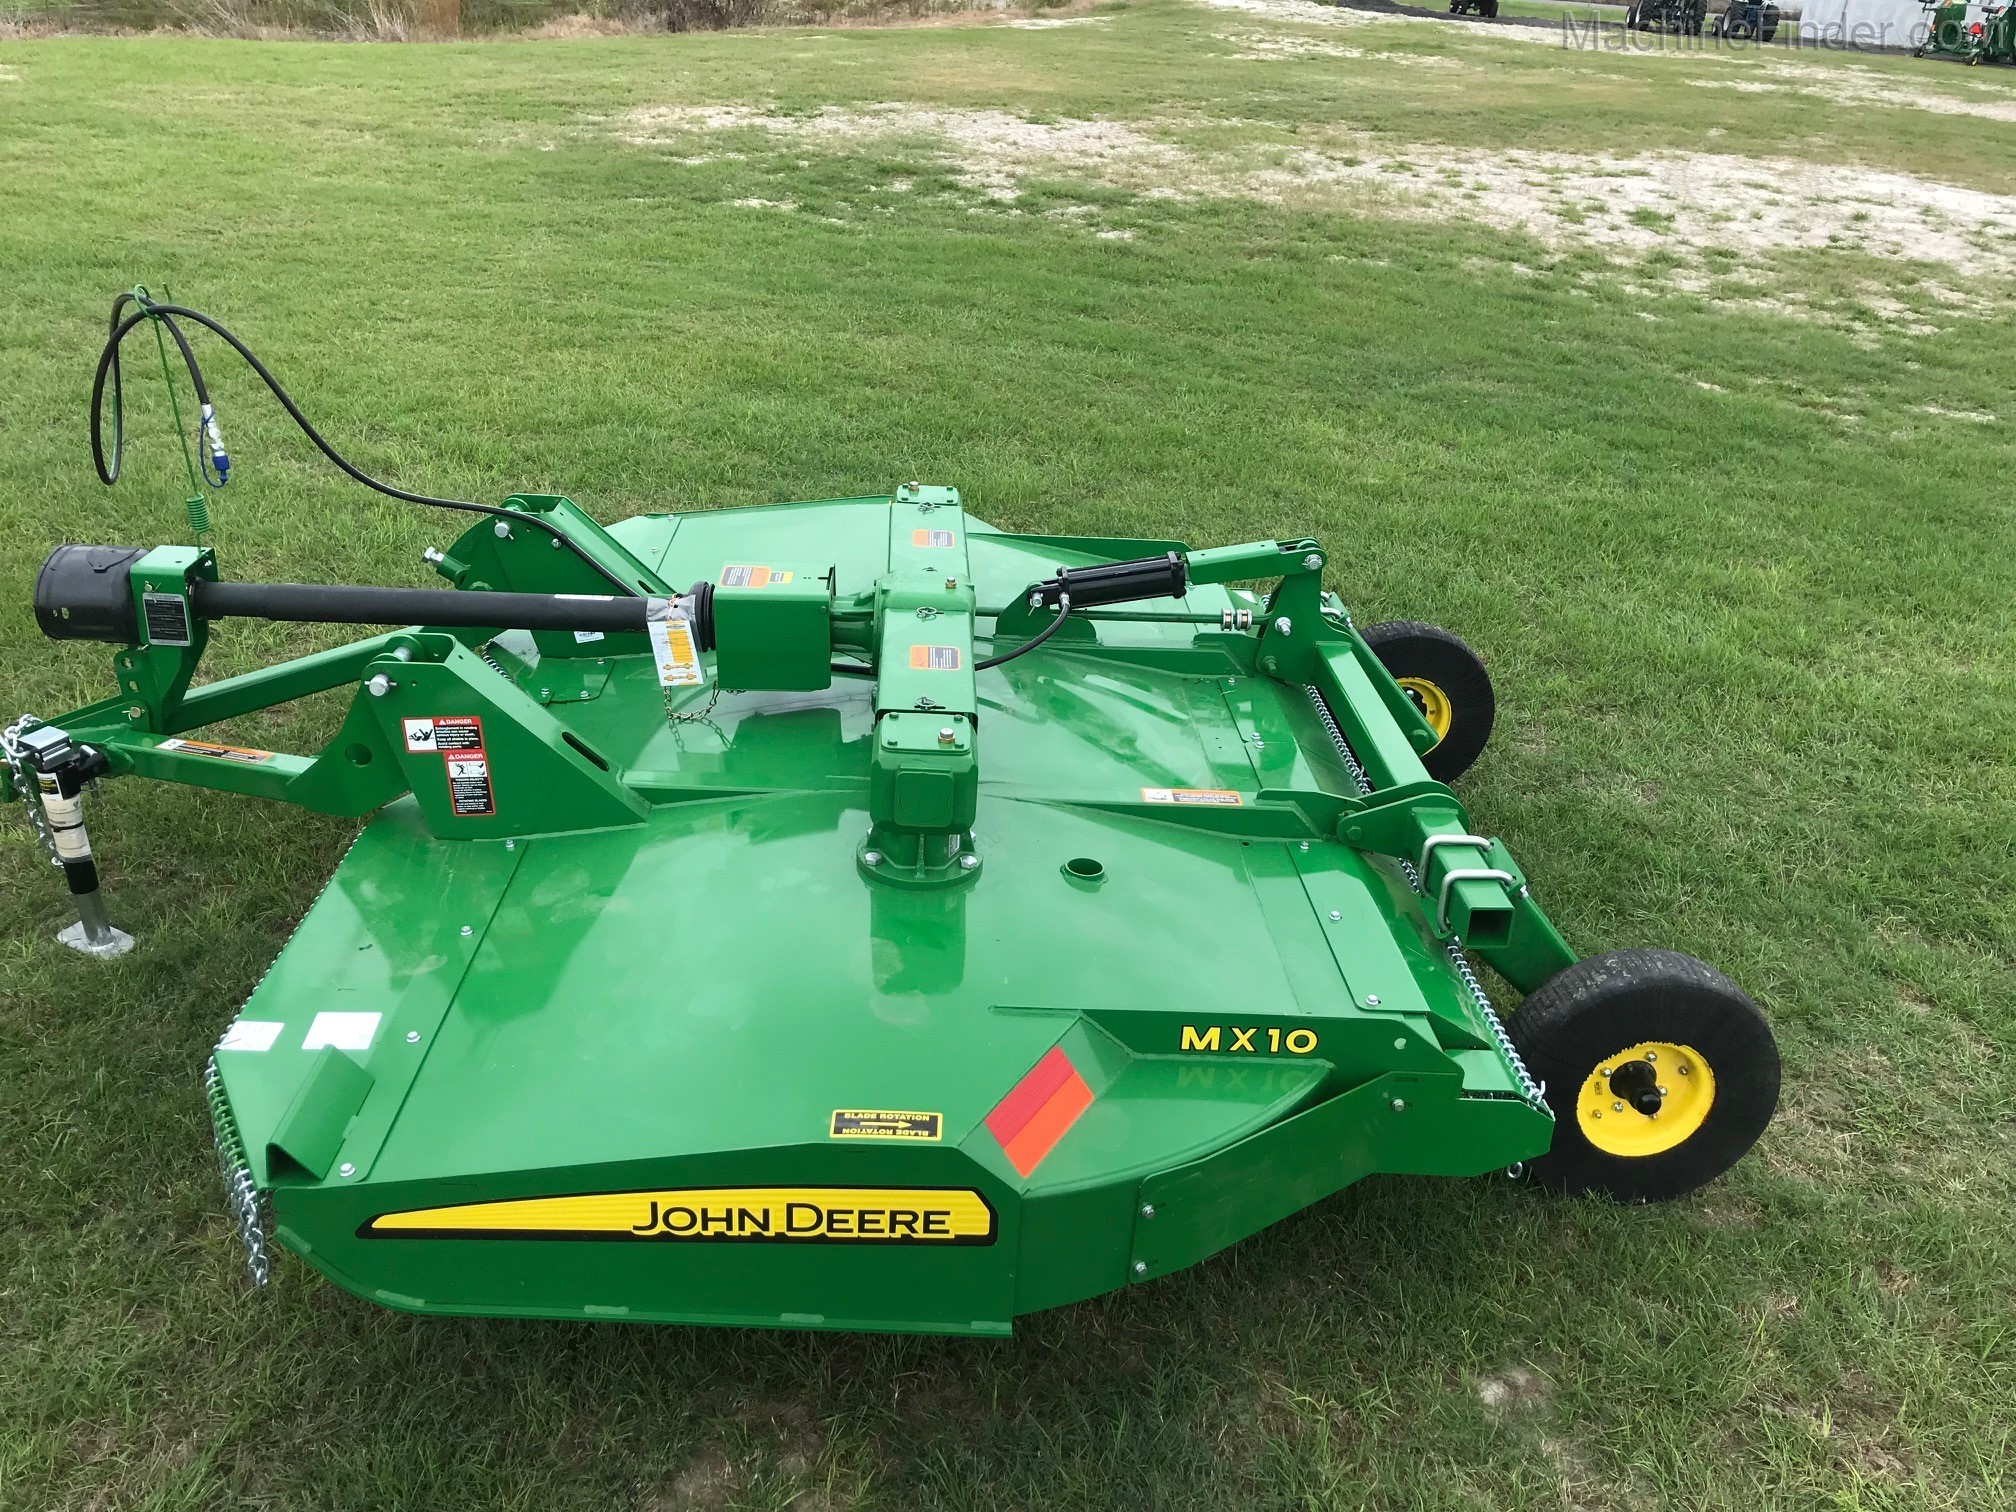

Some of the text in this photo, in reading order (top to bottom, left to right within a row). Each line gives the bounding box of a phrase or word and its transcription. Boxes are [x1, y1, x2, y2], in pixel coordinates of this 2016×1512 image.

[1180, 1025, 1319, 1055] MX10
[879, 1112, 930, 1121] ROTATION
[842, 1127, 929, 1137] BLADE ROTATION
[632, 1200, 953, 1236] JOHN DEERE
